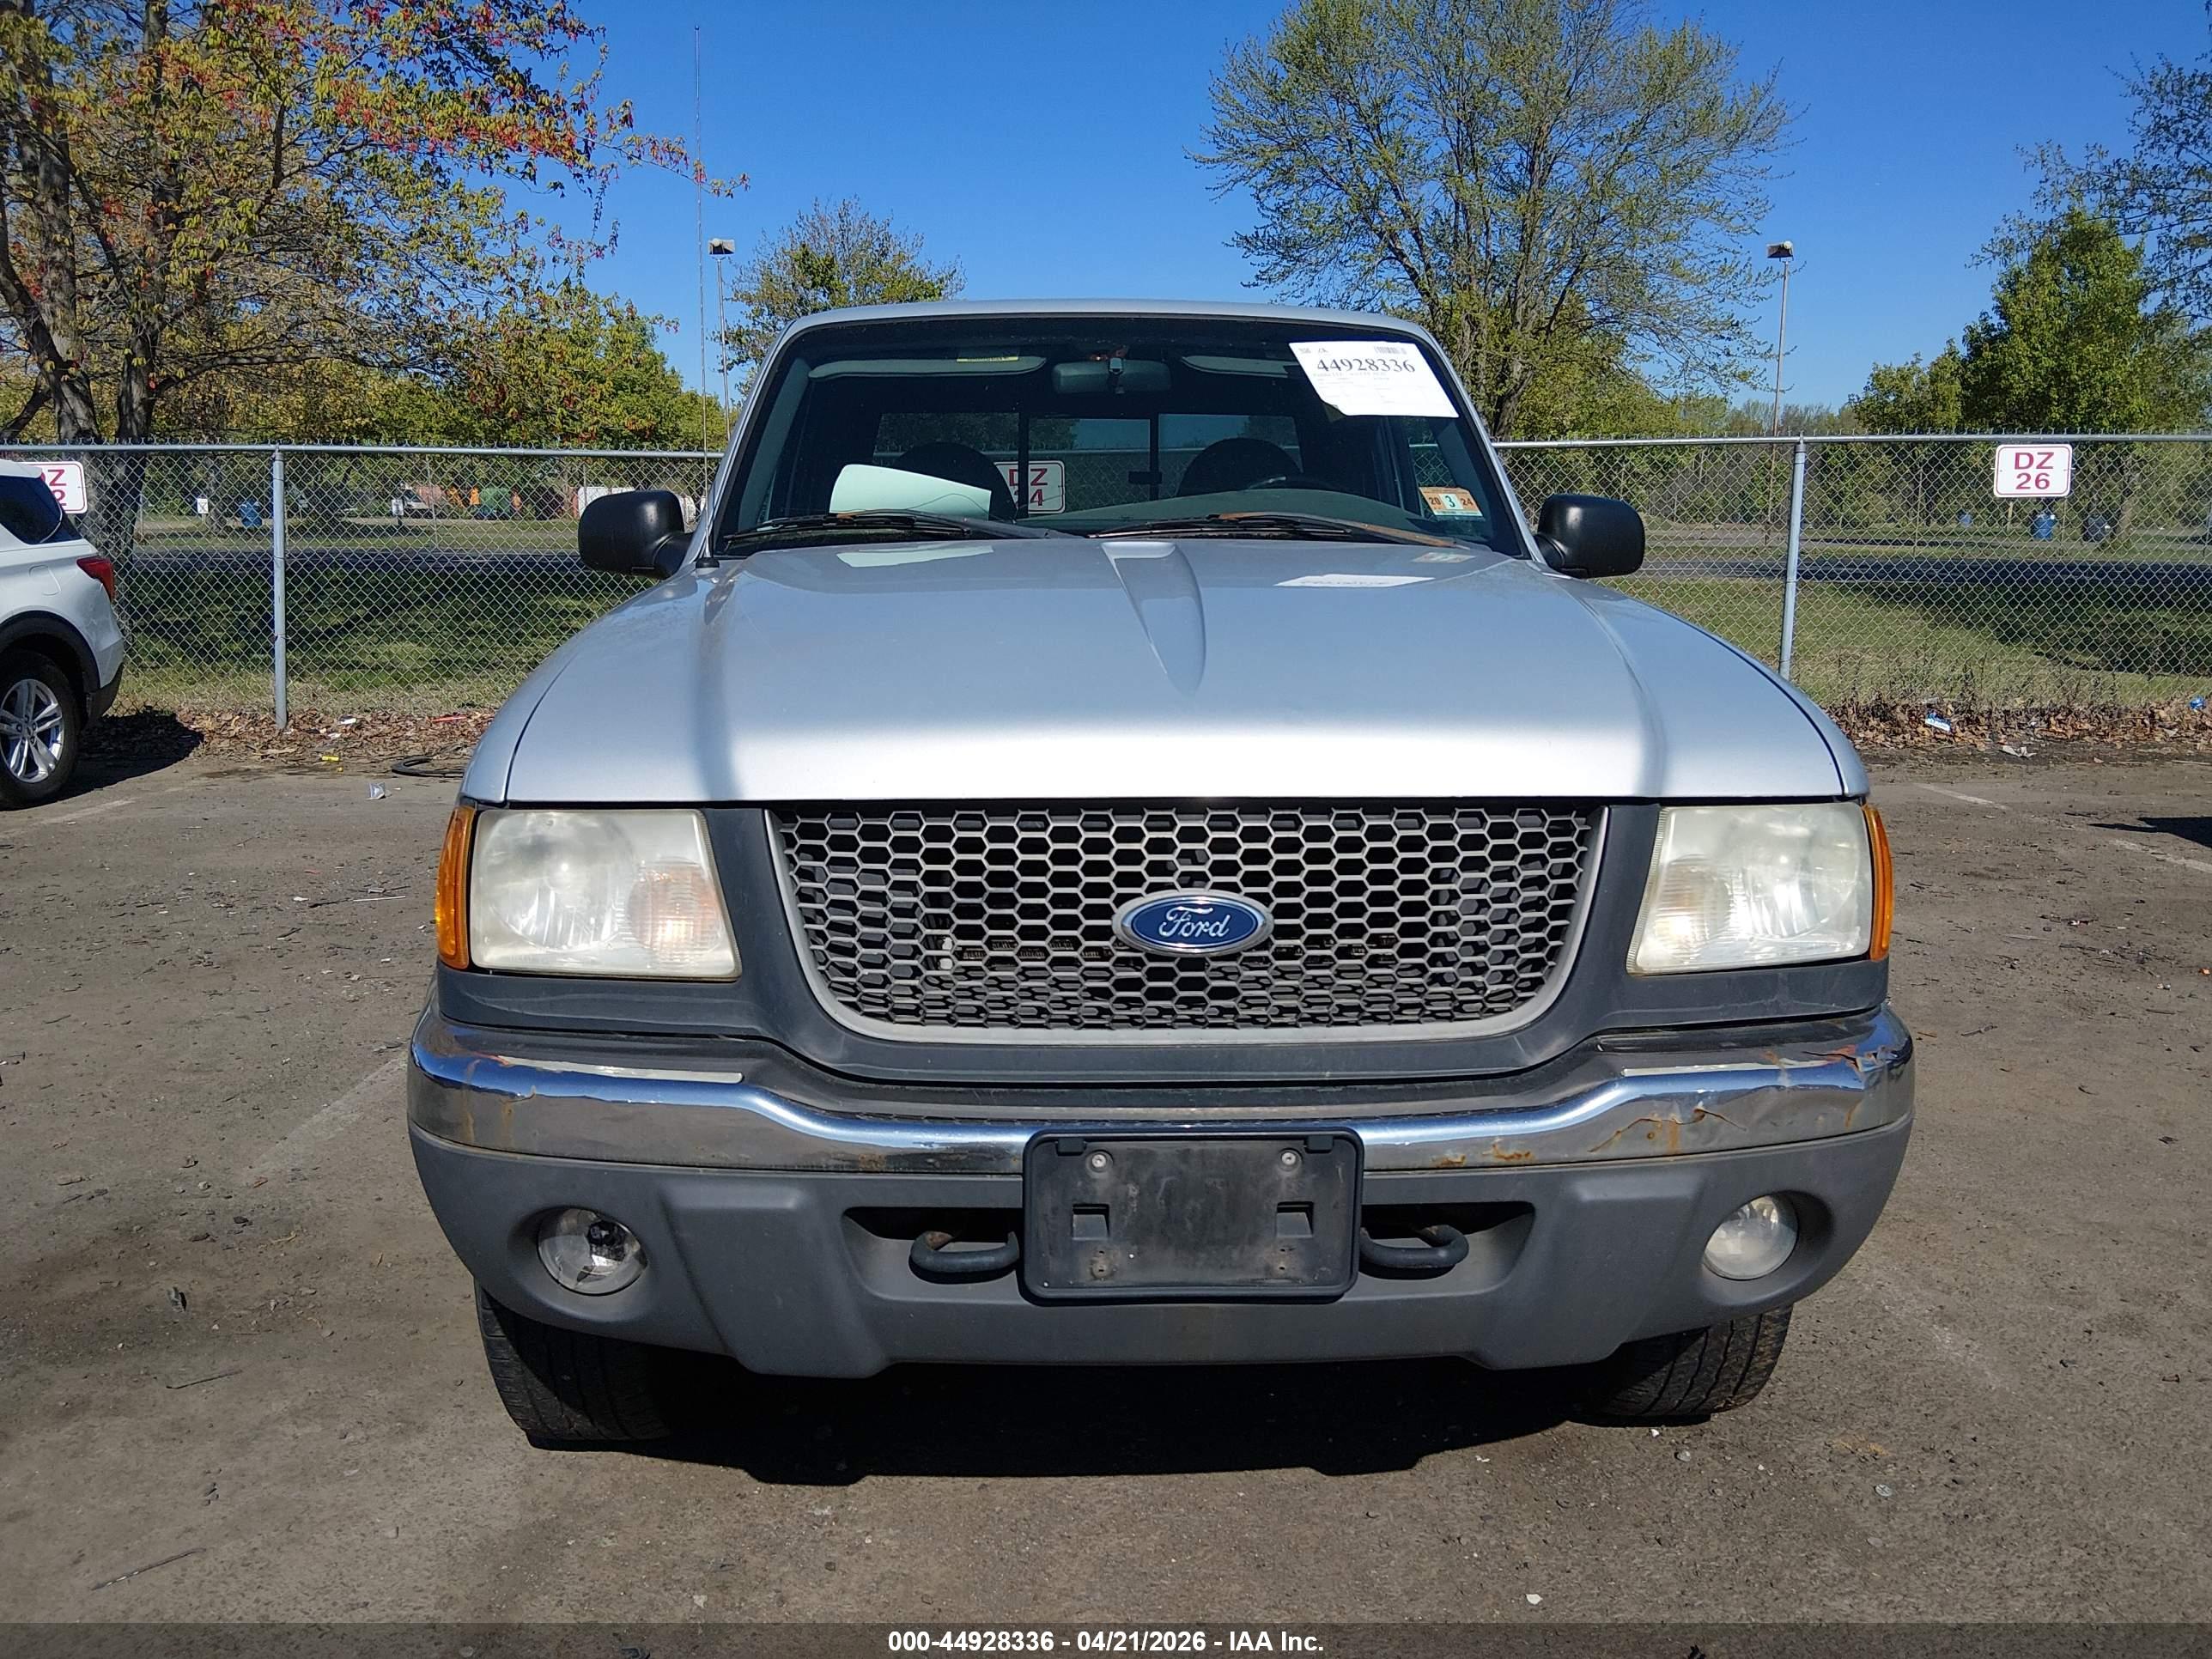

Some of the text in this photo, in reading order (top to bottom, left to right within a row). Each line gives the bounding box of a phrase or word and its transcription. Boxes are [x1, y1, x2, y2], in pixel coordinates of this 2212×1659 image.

[1317, 358, 1415, 373] 44928336
[2014, 452, 2054, 470] DZ
[40, 469, 67, 486] Z
[2015, 472, 2051, 489] 26
[1428, 496, 1442, 505] 20
[1444, 495, 1455, 507] 3
[1158, 906, 1231, 937] Ford
